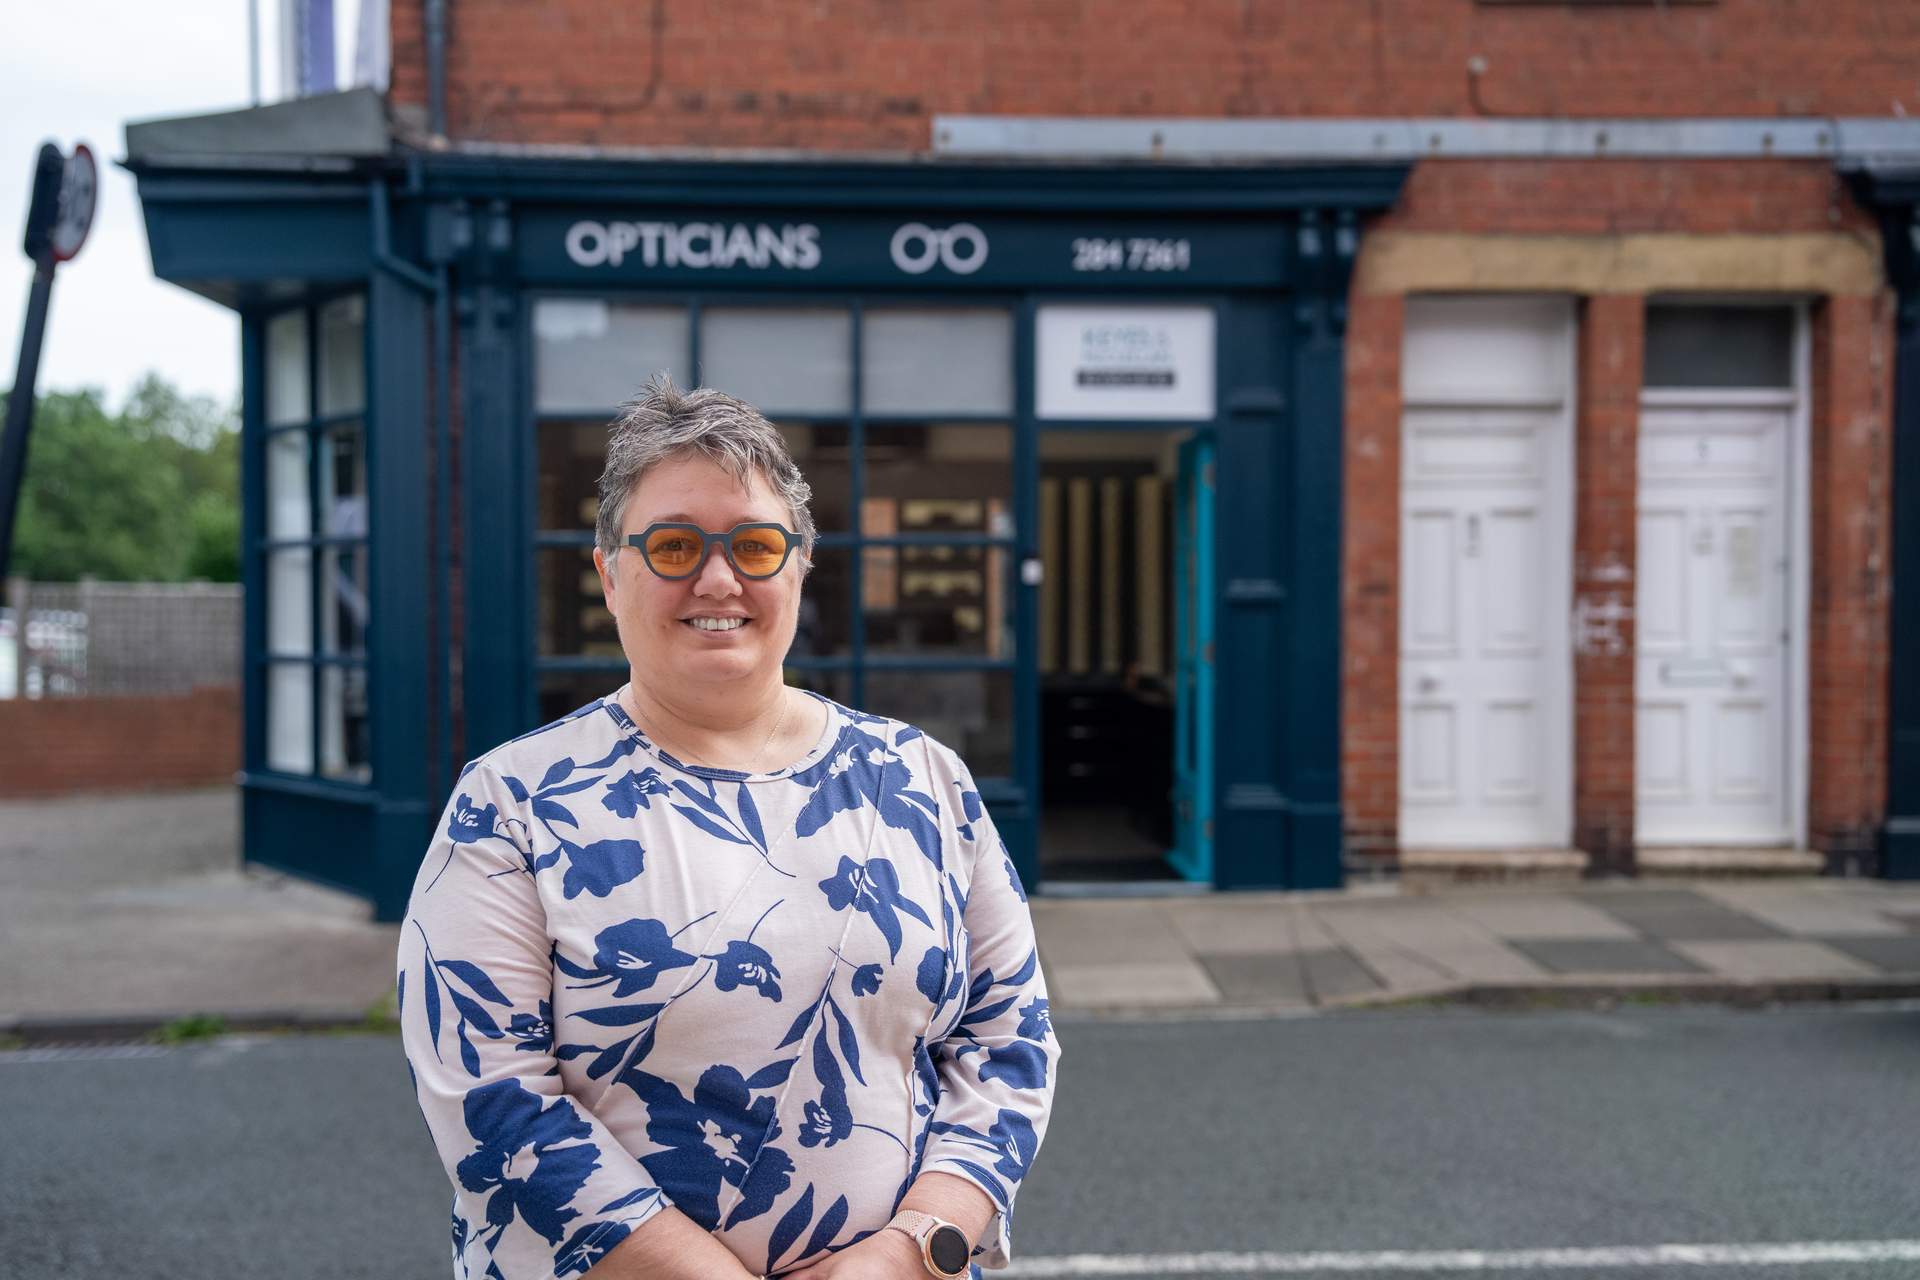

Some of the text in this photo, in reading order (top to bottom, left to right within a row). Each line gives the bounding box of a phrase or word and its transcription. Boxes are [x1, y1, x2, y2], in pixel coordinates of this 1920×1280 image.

[565, 220, 822, 270] OPTICIANS
[1071, 237, 1191, 272] 284 7361
